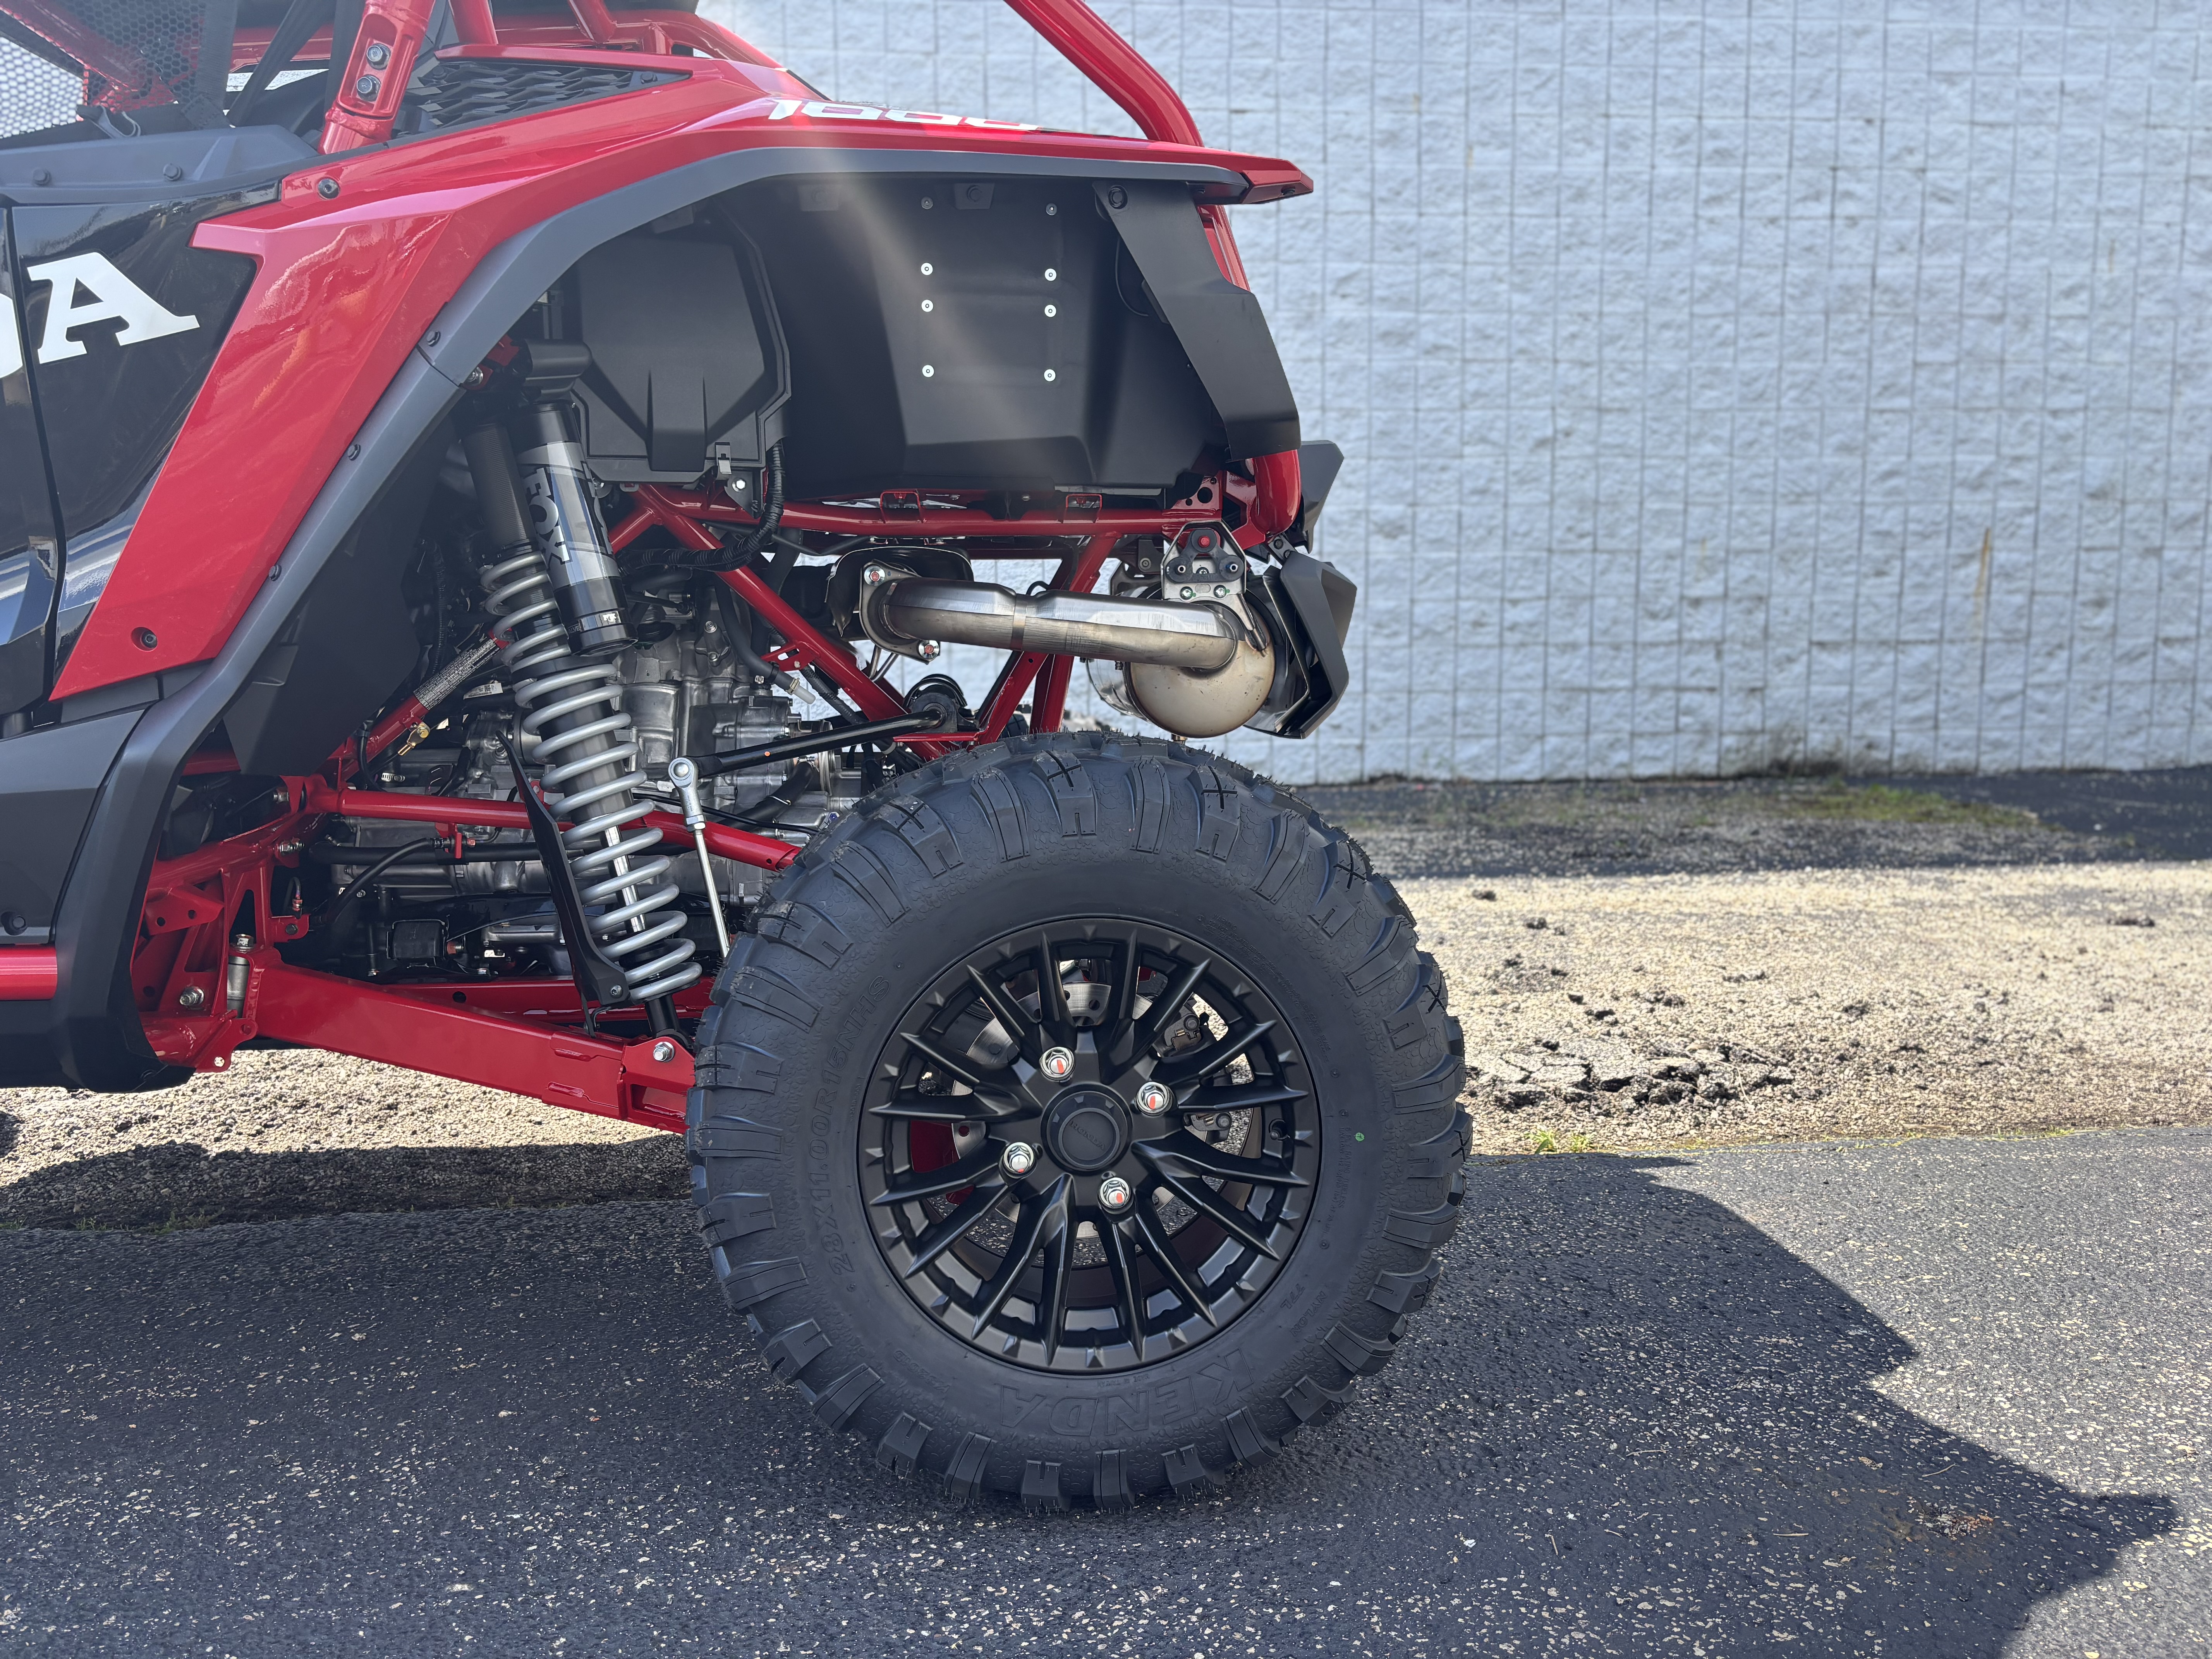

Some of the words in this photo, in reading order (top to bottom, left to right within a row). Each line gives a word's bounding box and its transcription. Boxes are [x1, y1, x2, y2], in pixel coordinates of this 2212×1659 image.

[1068, 1120, 1106, 1151] HONDA
[1280, 1283, 1305, 1310] 77L
[1290, 1290, 1328, 1336] NYLON
[1000, 1348, 1255, 1436] KENDA
